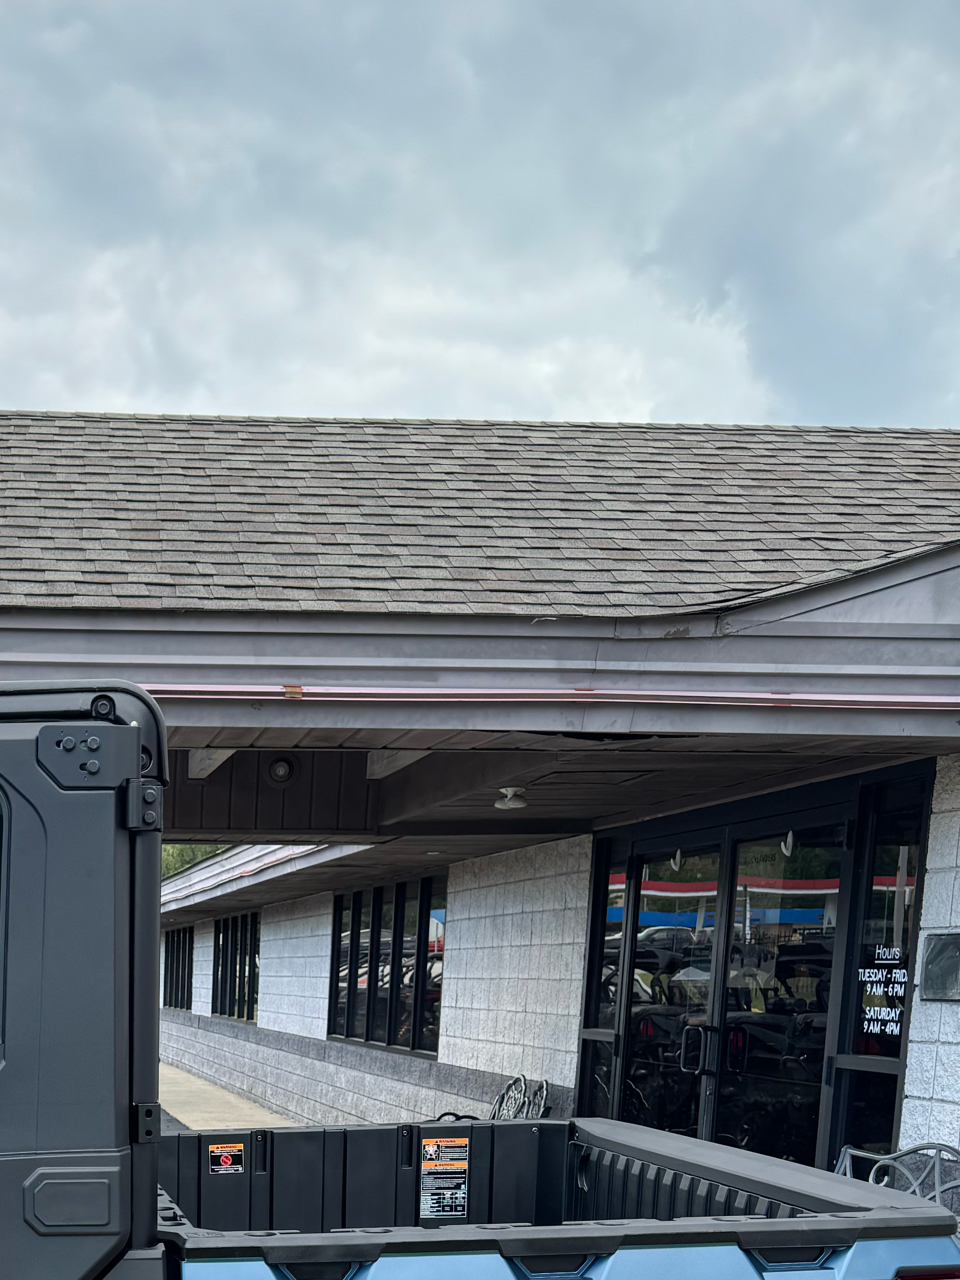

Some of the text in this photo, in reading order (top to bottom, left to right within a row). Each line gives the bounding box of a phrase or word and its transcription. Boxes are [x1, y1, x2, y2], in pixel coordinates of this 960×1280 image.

[876, 945, 900, 959] Hours
[858, 968, 887, 981] TUESDAY
[892, 969, 908, 982] FRID
[872, 984, 884, 996] AM
[893, 984, 905, 996] PM
[865, 1007, 900, 1020] SATURDAY
